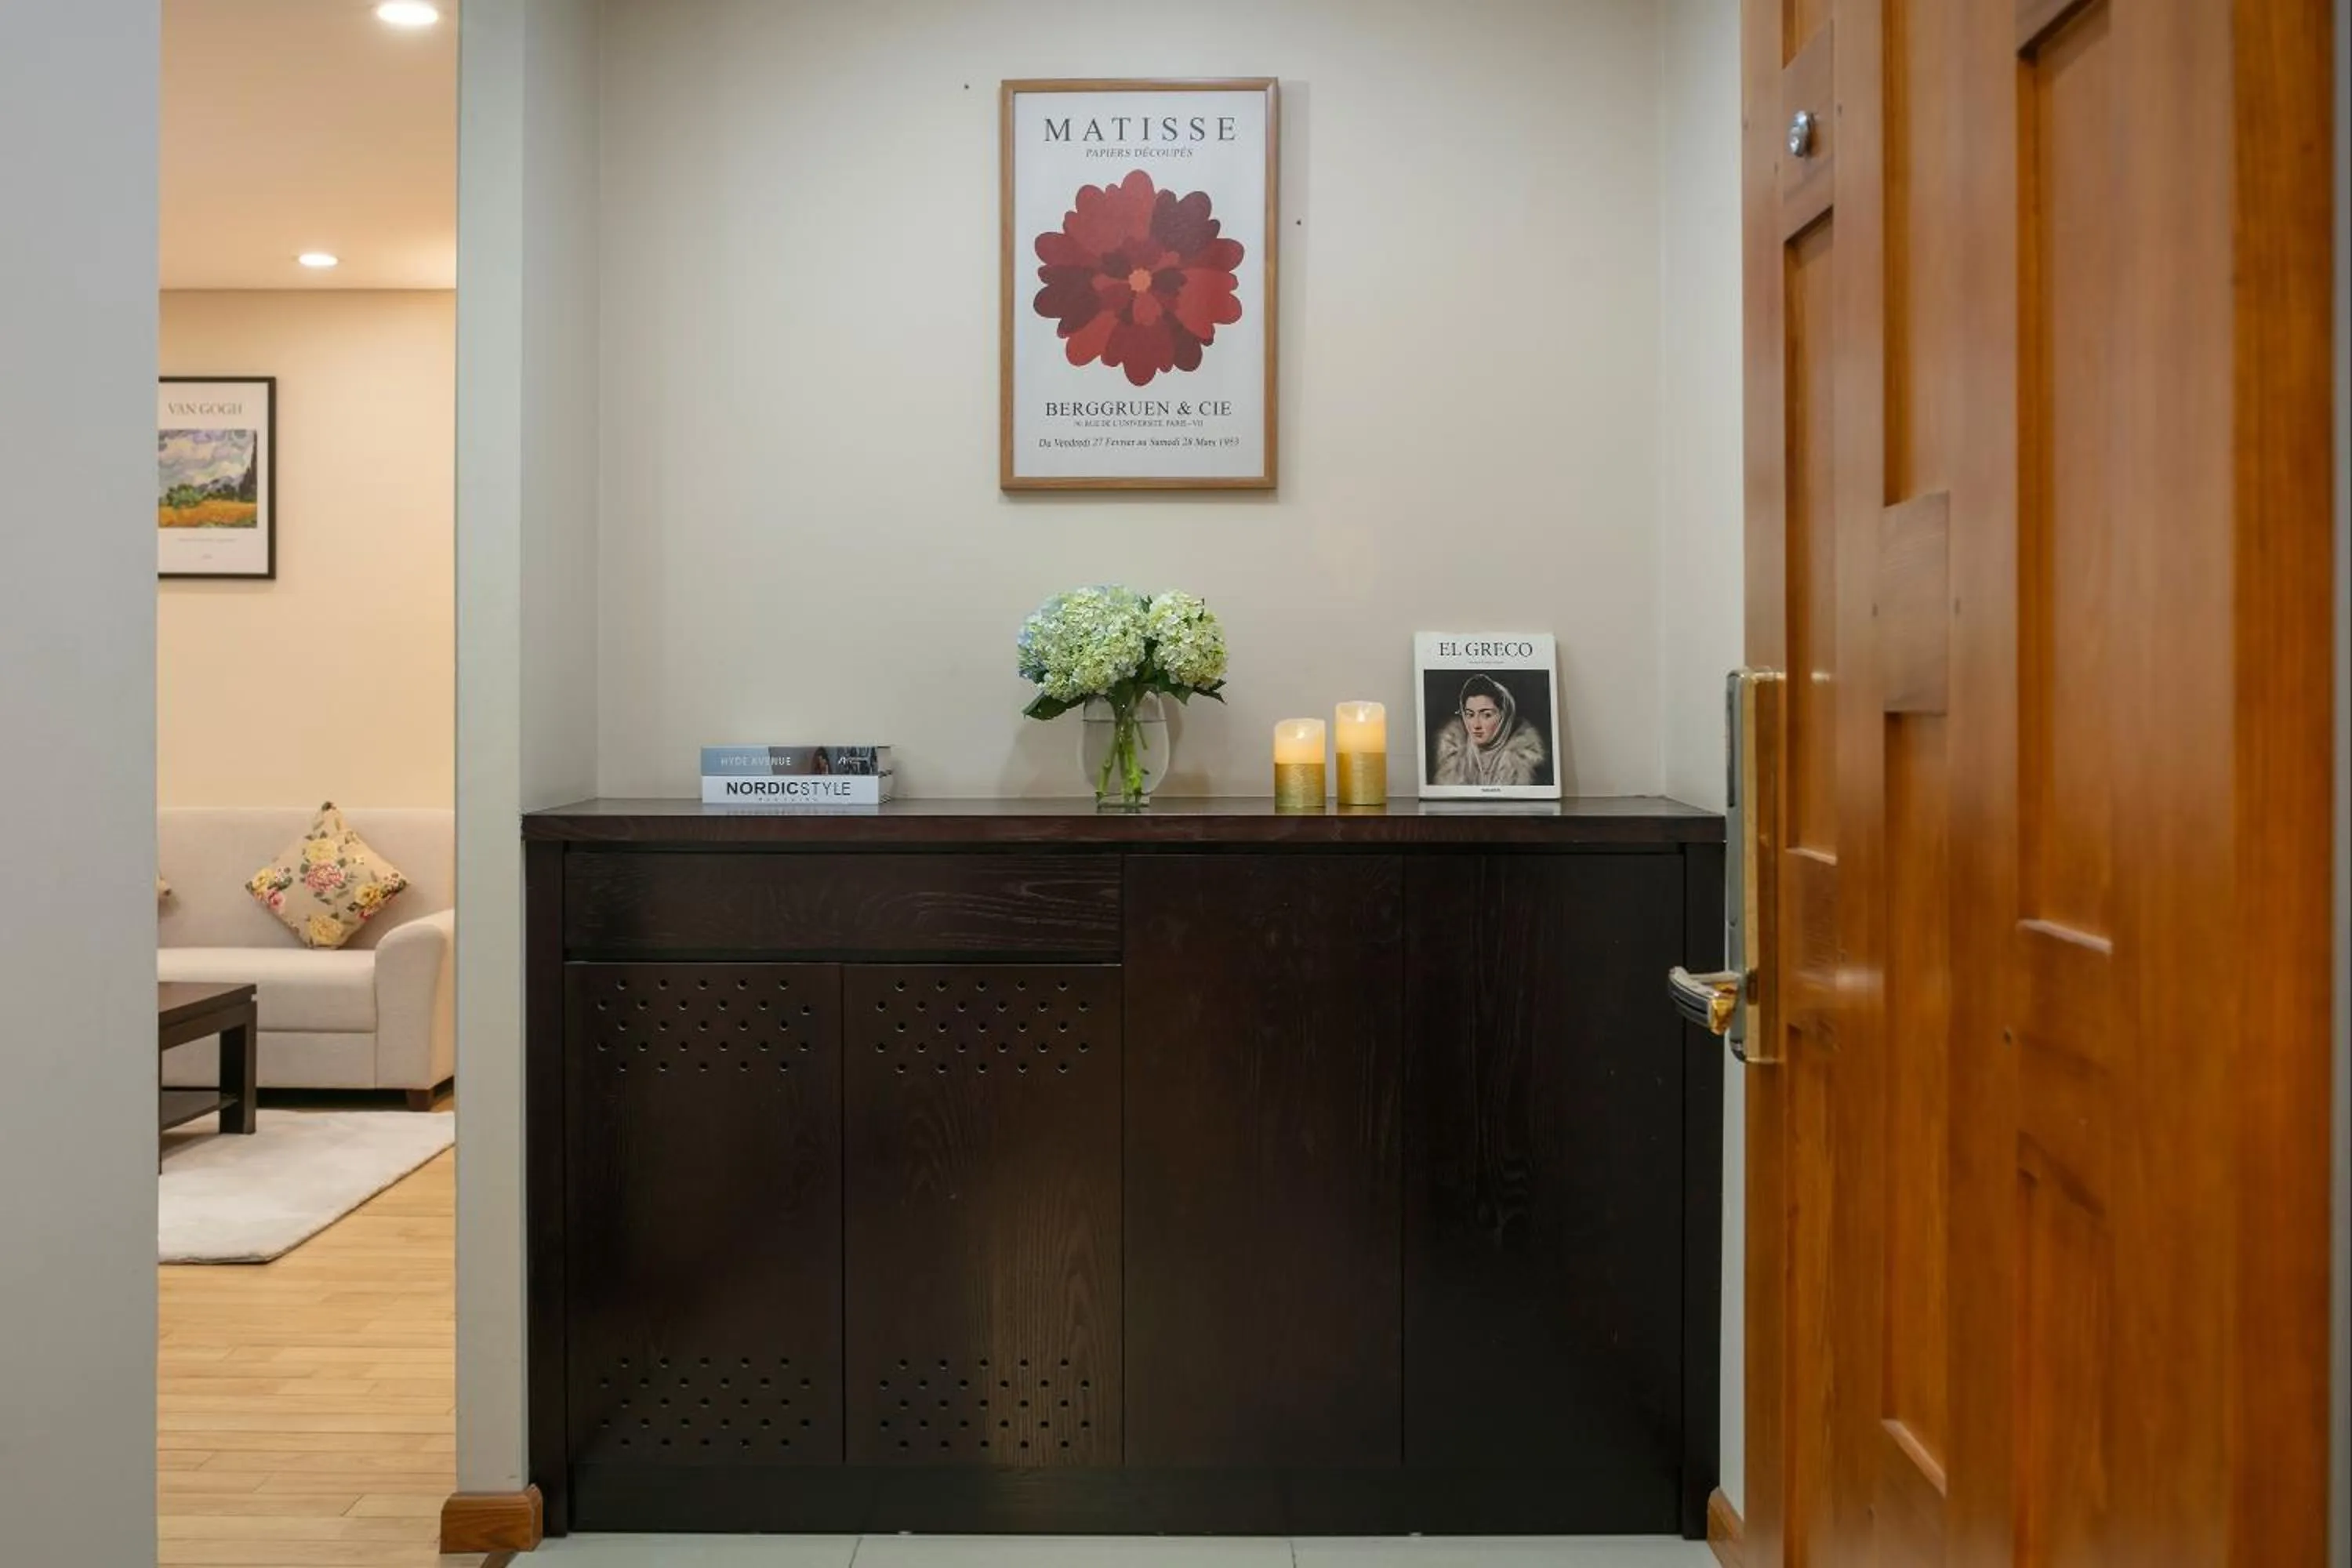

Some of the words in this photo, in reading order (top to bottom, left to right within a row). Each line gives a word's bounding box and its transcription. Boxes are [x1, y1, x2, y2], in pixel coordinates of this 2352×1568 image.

[1044, 117, 1236, 142] MATISSE
[1086, 148, 1131, 158] PAPIERS
[168, 402, 196, 415] VAN
[198, 402, 242, 415] GOGH
[1045, 401, 1170, 416] BERGGRUEN
[1177, 401, 1192, 416] &
[1199, 401, 1232, 416] CIE
[1439, 642, 1461, 655] EL
[1465, 641, 1533, 657] GRECO
[720, 756, 748, 766] HYDE
[749, 757, 792, 766] AVENUE
